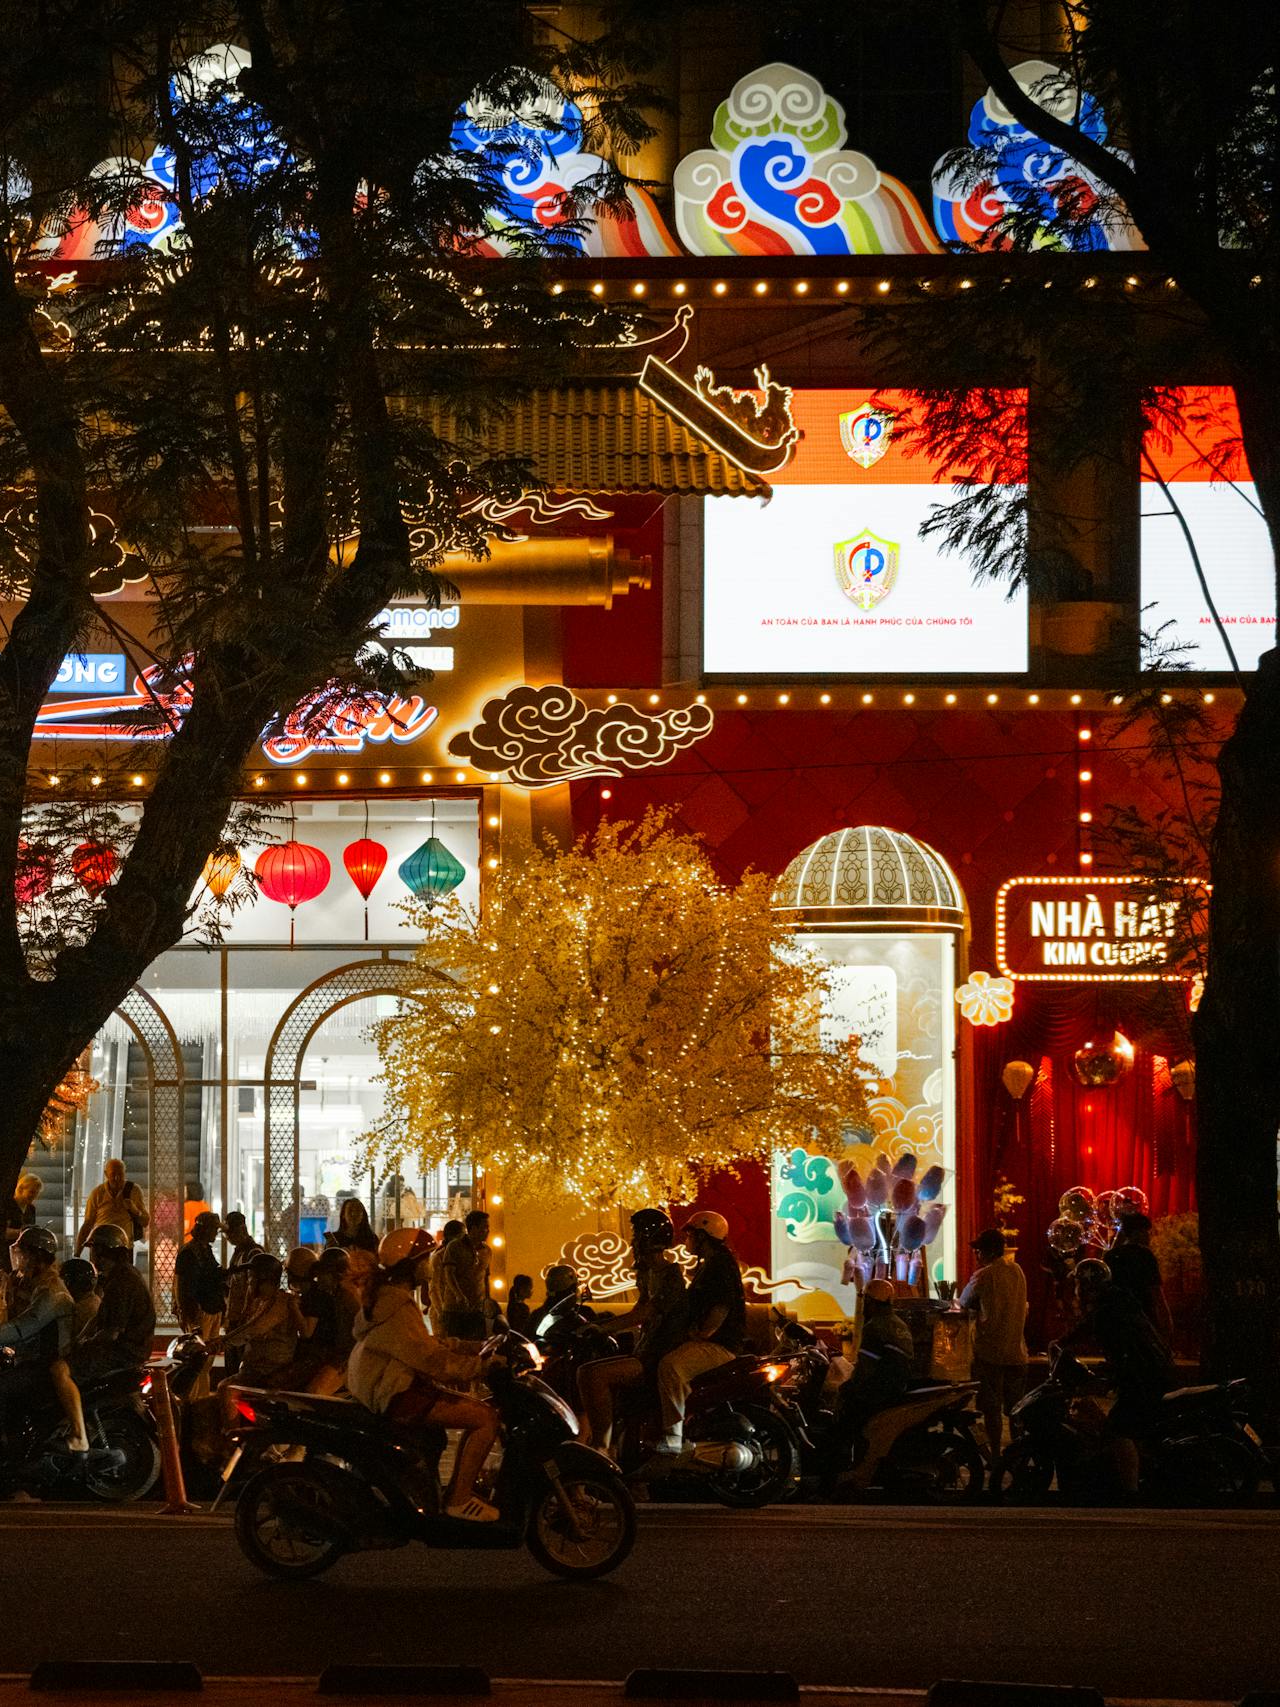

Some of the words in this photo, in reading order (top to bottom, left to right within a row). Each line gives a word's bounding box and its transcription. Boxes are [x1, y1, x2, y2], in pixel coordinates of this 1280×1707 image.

[761, 618, 773, 626] AN
[1031, 893, 1106, 938] NHÀ
[1113, 893, 1181, 938] HÁT
[1043, 941, 1087, 966] KIM
